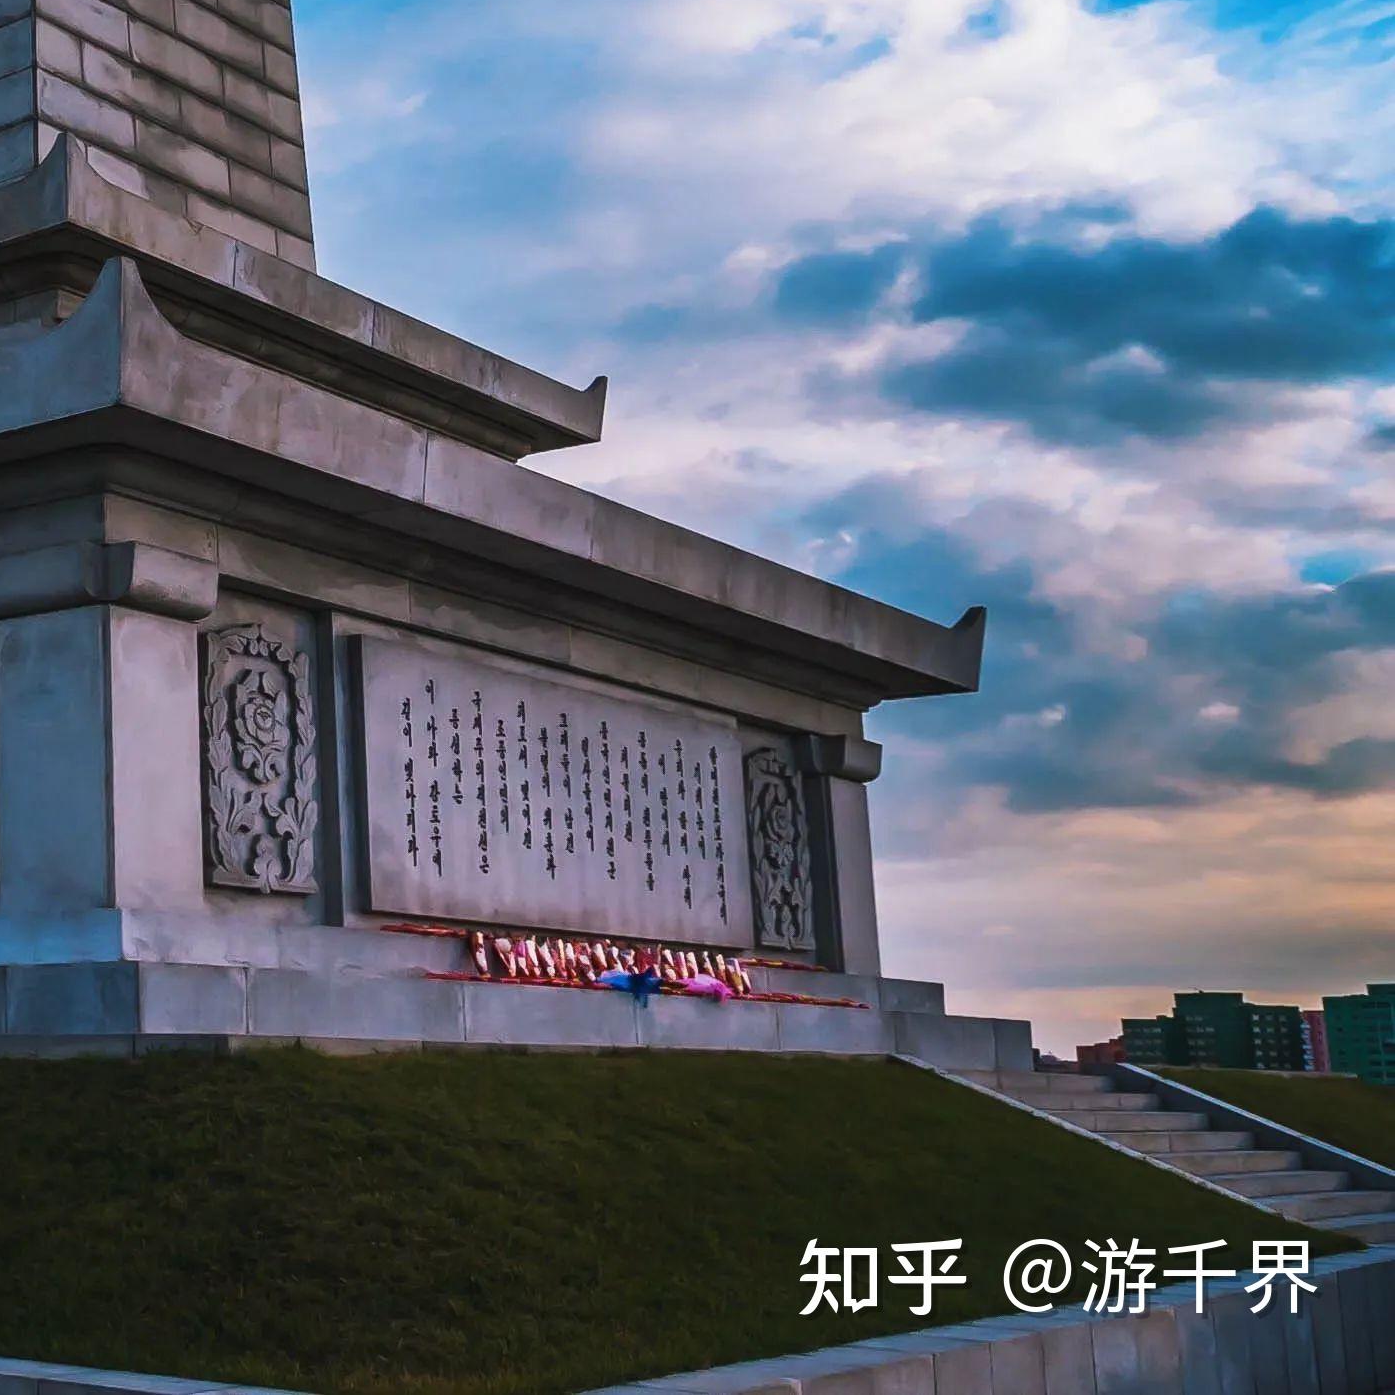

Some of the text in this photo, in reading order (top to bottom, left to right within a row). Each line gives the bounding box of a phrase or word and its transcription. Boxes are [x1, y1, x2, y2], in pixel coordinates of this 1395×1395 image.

[423, 678, 435, 706] 이
[424, 713, 440, 771] 나라
[398, 696, 421, 869] 길이 빛나리라
